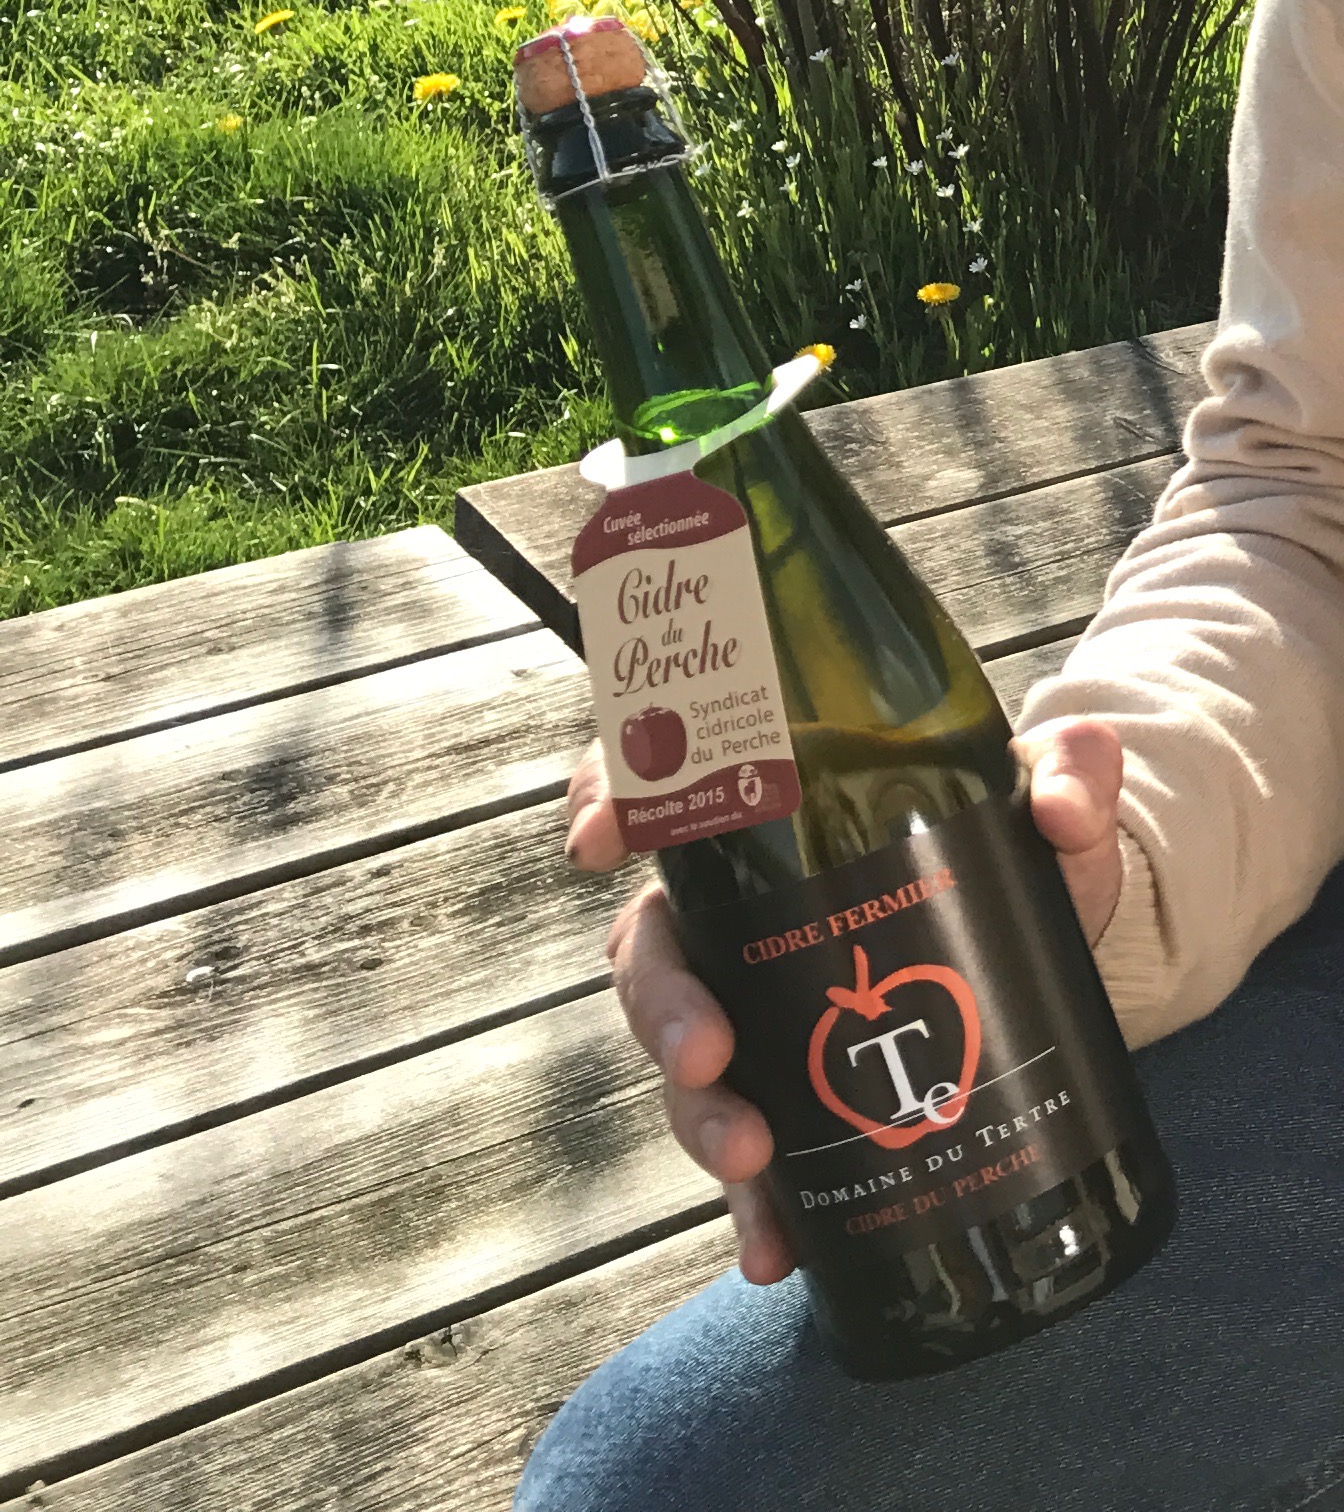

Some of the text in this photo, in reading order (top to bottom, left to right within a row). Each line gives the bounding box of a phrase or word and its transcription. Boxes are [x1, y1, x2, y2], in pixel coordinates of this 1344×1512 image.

[603, 510, 642, 534] Cuvée
[627, 511, 710, 545] sélectionnée
[617, 559, 710, 624] Cidre
[661, 618, 683, 646] du
[612, 620, 737, 698] Perche
[689, 685, 768, 719] Syndicat
[696, 709, 775, 740] cidricole
[690, 730, 782, 765] du Perche
[627, 800, 684, 826] Récolte
[688, 787, 725, 811] 2015
[743, 868, 957, 965] CIDRE FERMIER
[846, 1142, 1044, 1235] CIDRE DU PERCHE
